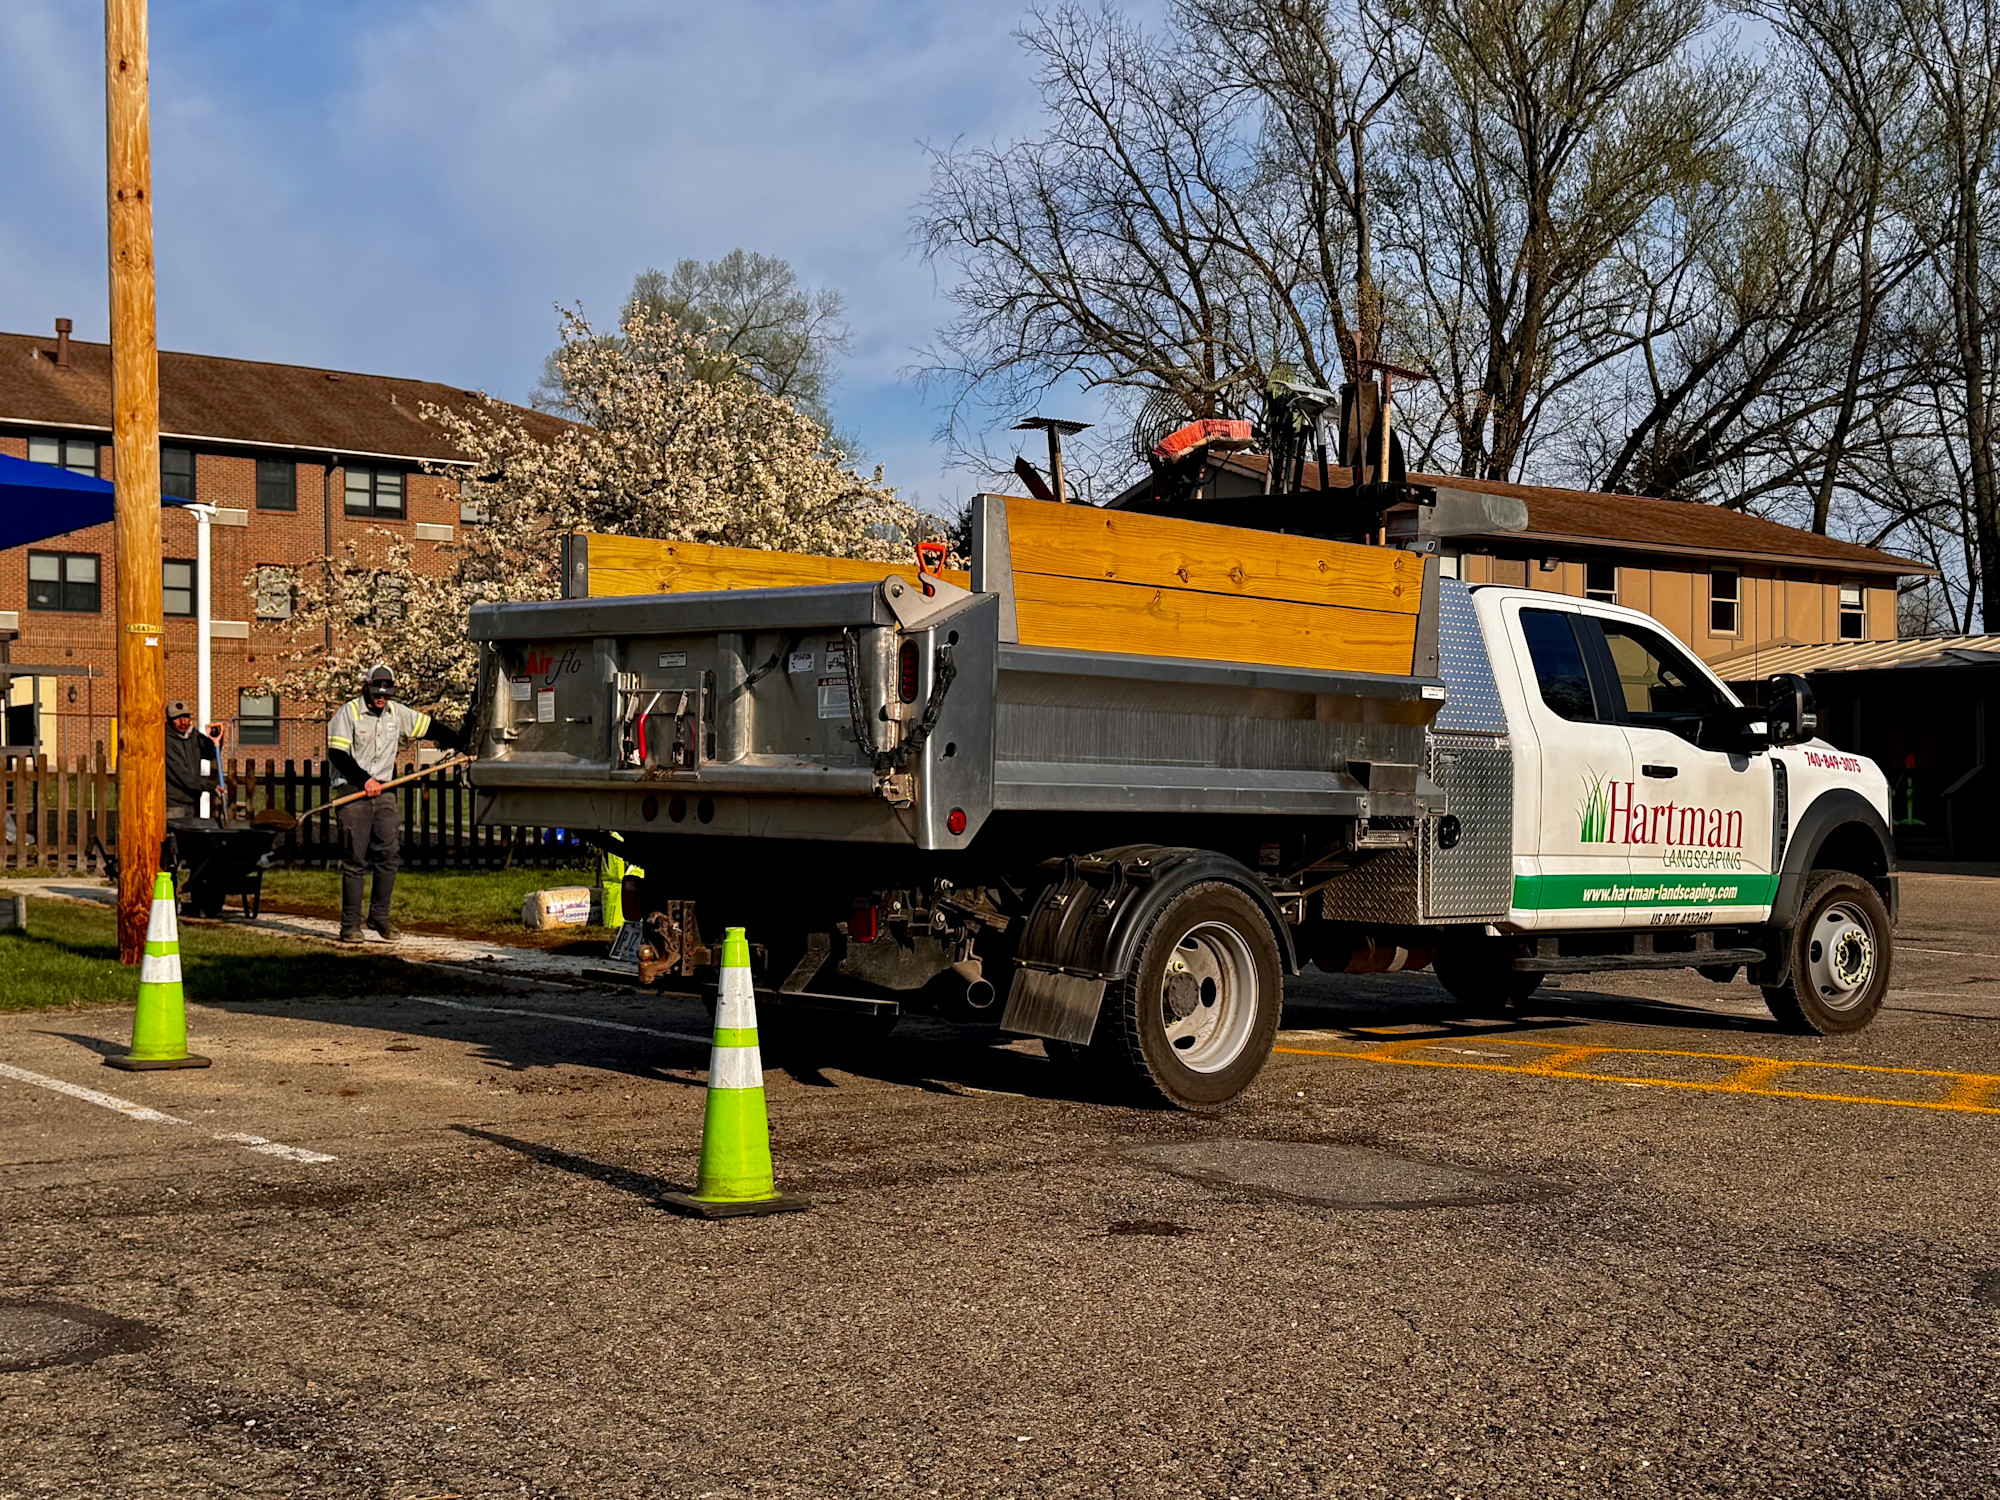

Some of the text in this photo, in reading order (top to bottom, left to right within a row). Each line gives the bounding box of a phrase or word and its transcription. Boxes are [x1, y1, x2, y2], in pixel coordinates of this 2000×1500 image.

[1804, 751, 1861, 773] 740-849-3075
[1606, 781, 1743, 848] Hartman
[1662, 848, 1743, 871] LANDSCAPING
[1582, 883, 1739, 903] www.hartman-landscaping.com
[1650, 911, 1713, 925] US DOT 4132691
